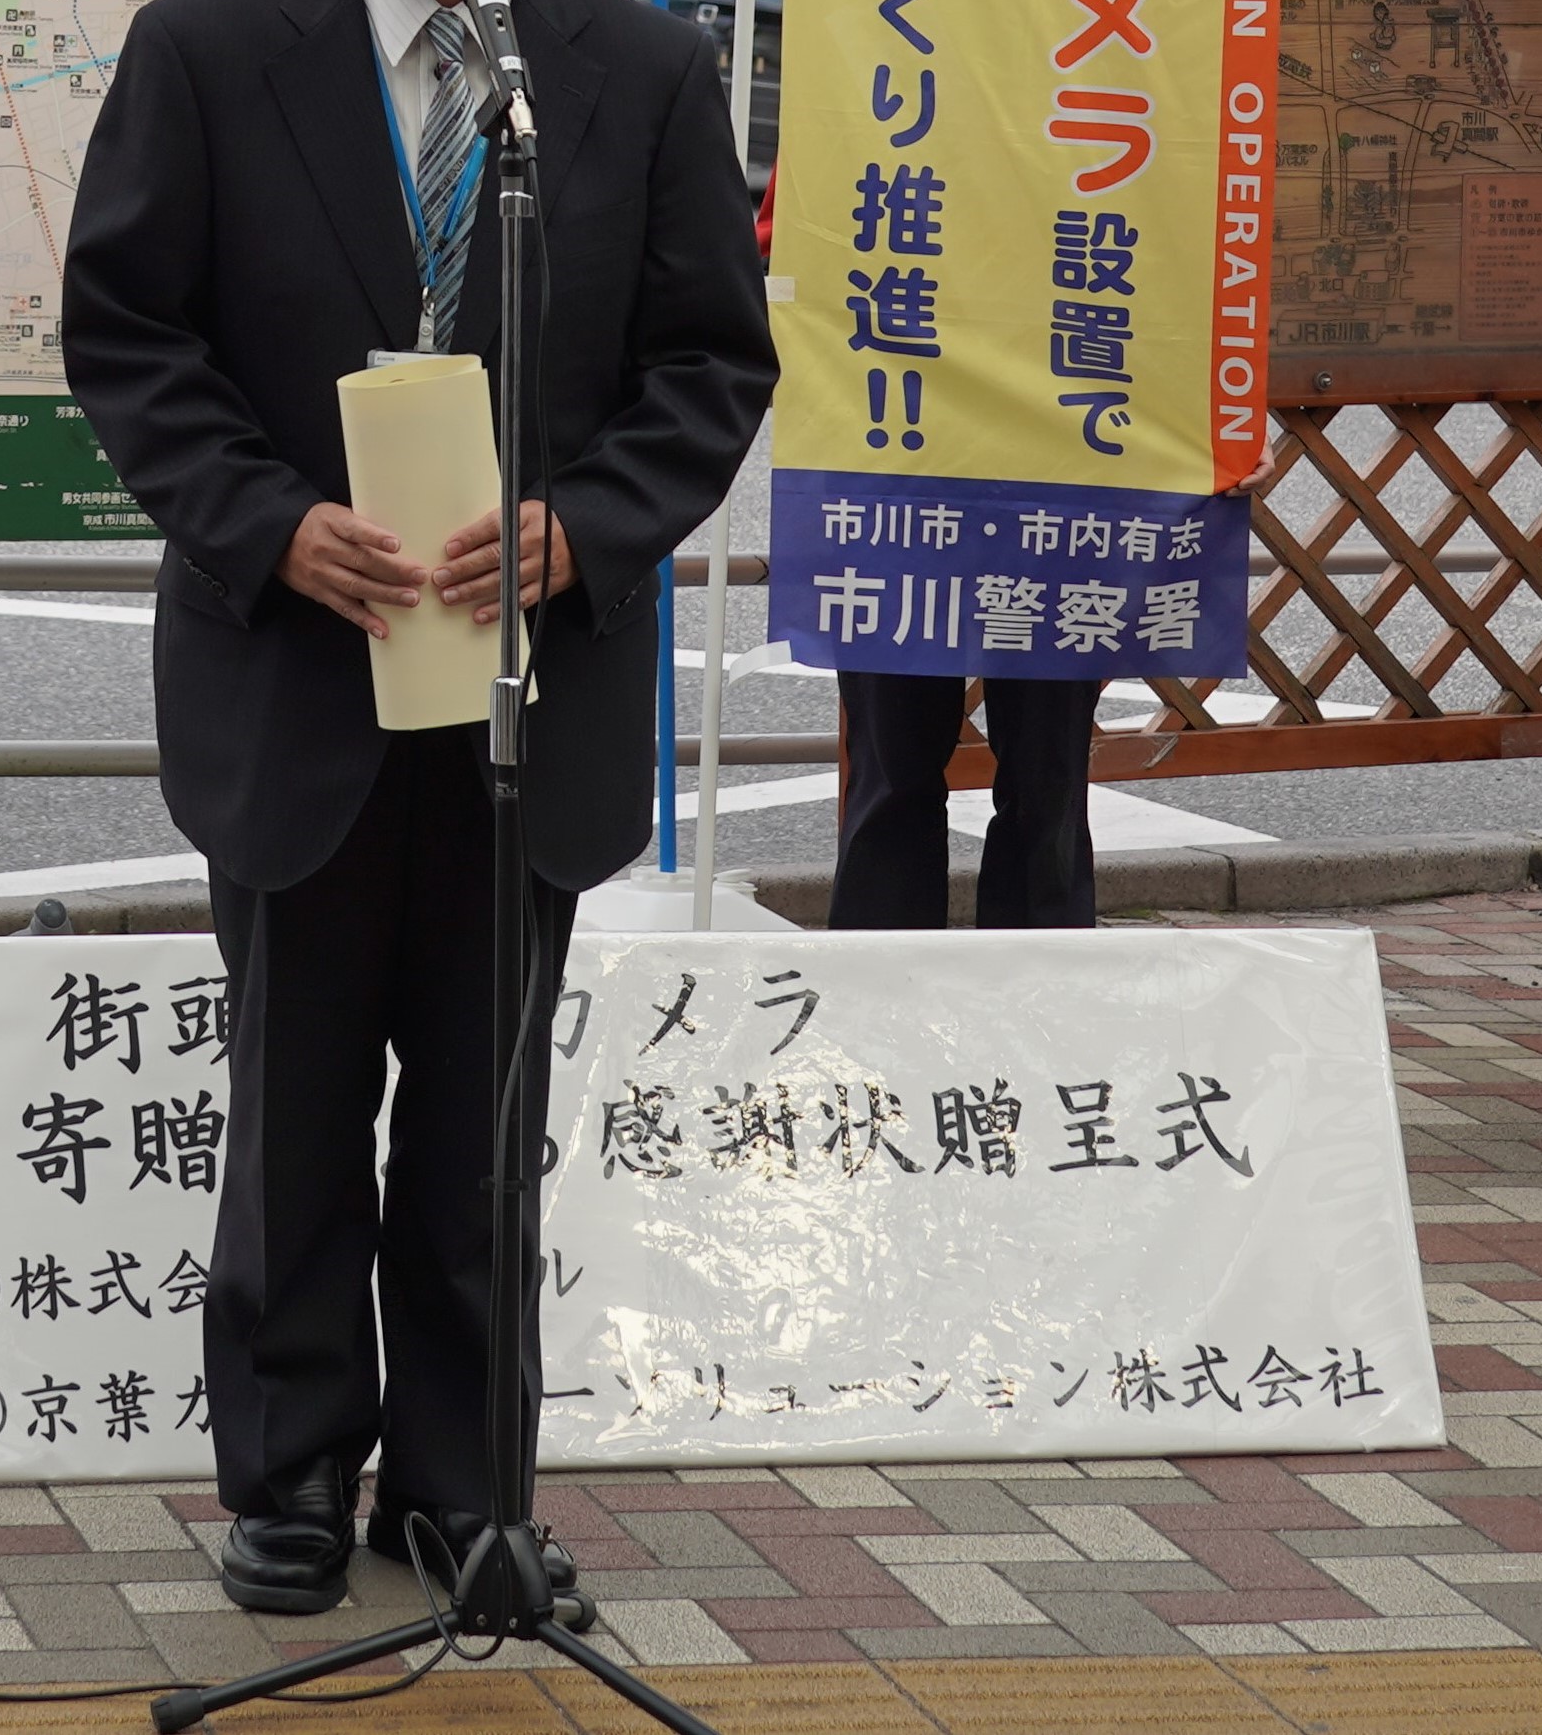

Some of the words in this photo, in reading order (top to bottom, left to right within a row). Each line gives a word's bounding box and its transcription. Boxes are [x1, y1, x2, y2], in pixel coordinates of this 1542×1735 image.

[1217, 81, 1264, 443] OPERATION
[821, 498, 1206, 564] 市川市・市内有志
[812, 565, 1201, 653] 市川警察署
[15, 1089, 226, 1205] 寄贈
